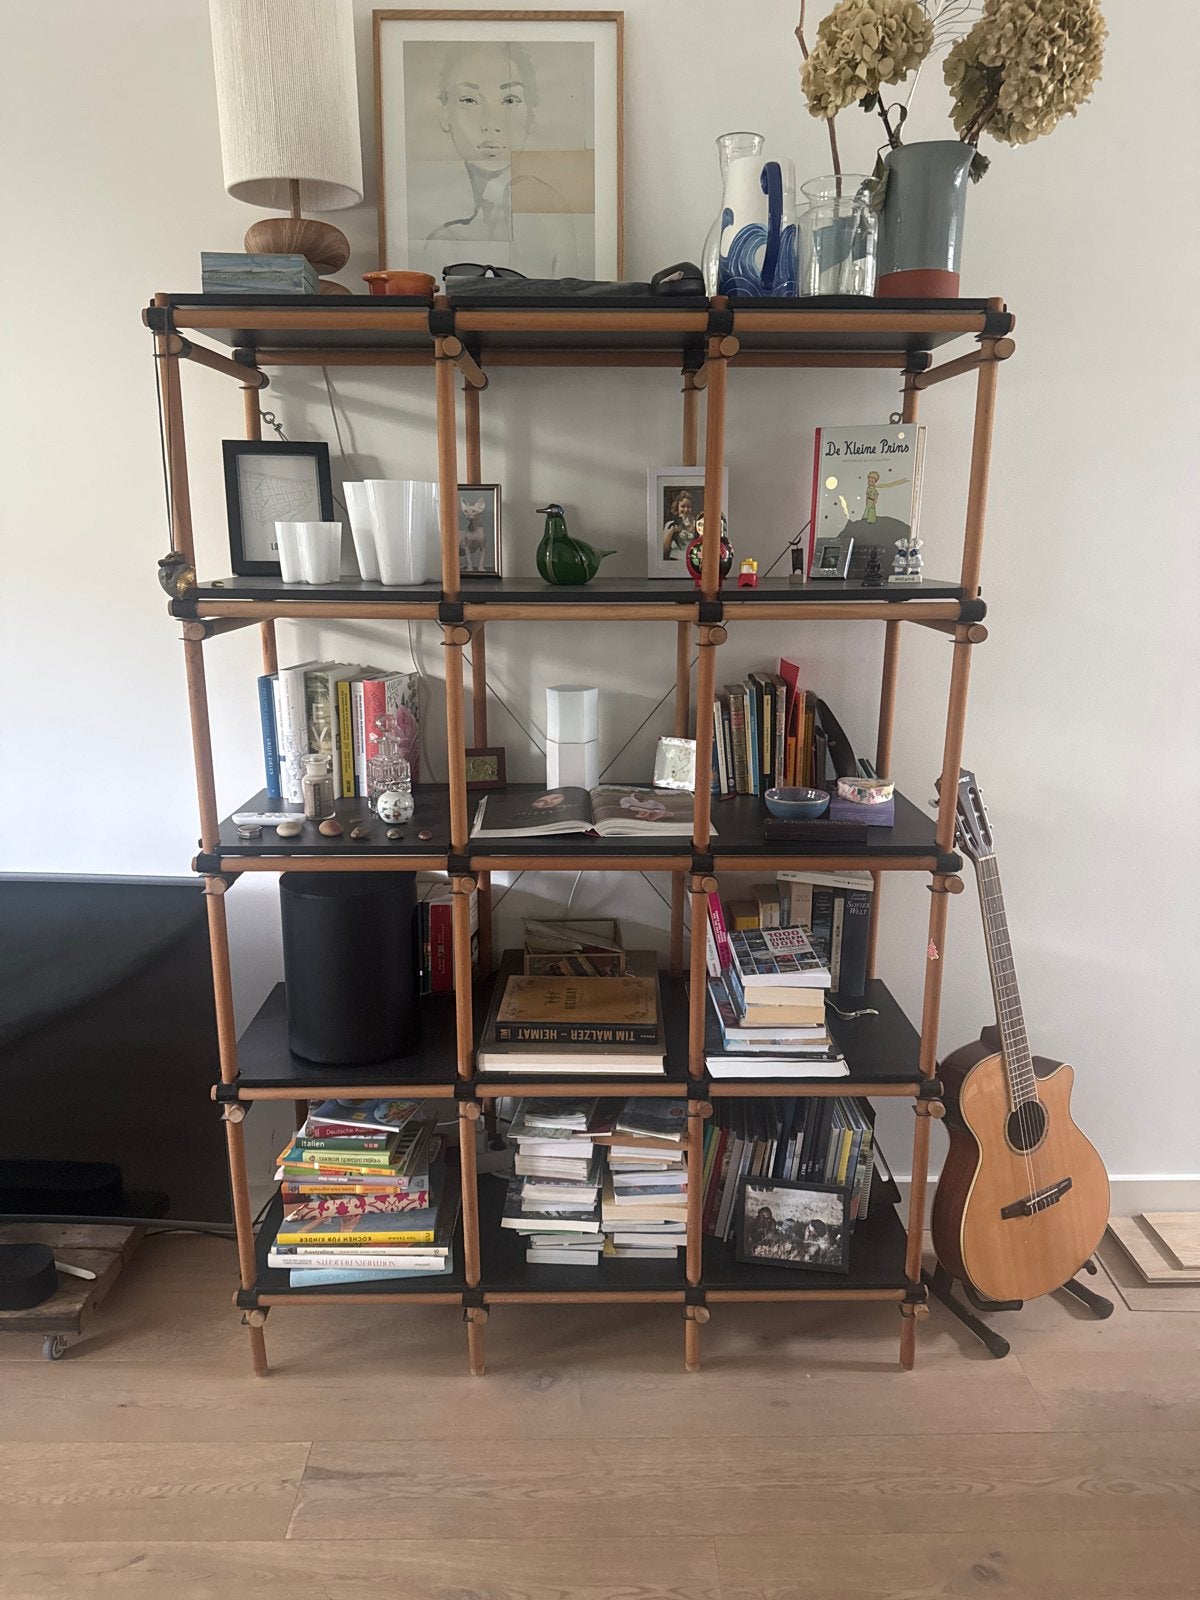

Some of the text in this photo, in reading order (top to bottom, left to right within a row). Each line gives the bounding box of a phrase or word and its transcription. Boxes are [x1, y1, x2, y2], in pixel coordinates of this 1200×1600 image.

[825, 438, 909, 456] De Kleine Prins
[847, 900, 870, 908] SOFIES
[850, 907, 867, 915] WELT
[767, 930, 800, 938] 1000
[771, 939, 805, 947] DOEN
[564, 987, 577, 1010] HEIMAT
[517, 1028, 557, 1040] HEIMAT
[570, 1029, 613, 1042] MÄLZER
[616, 1030, 635, 1041] TIM
[301, 1140, 325, 1148] Italien
